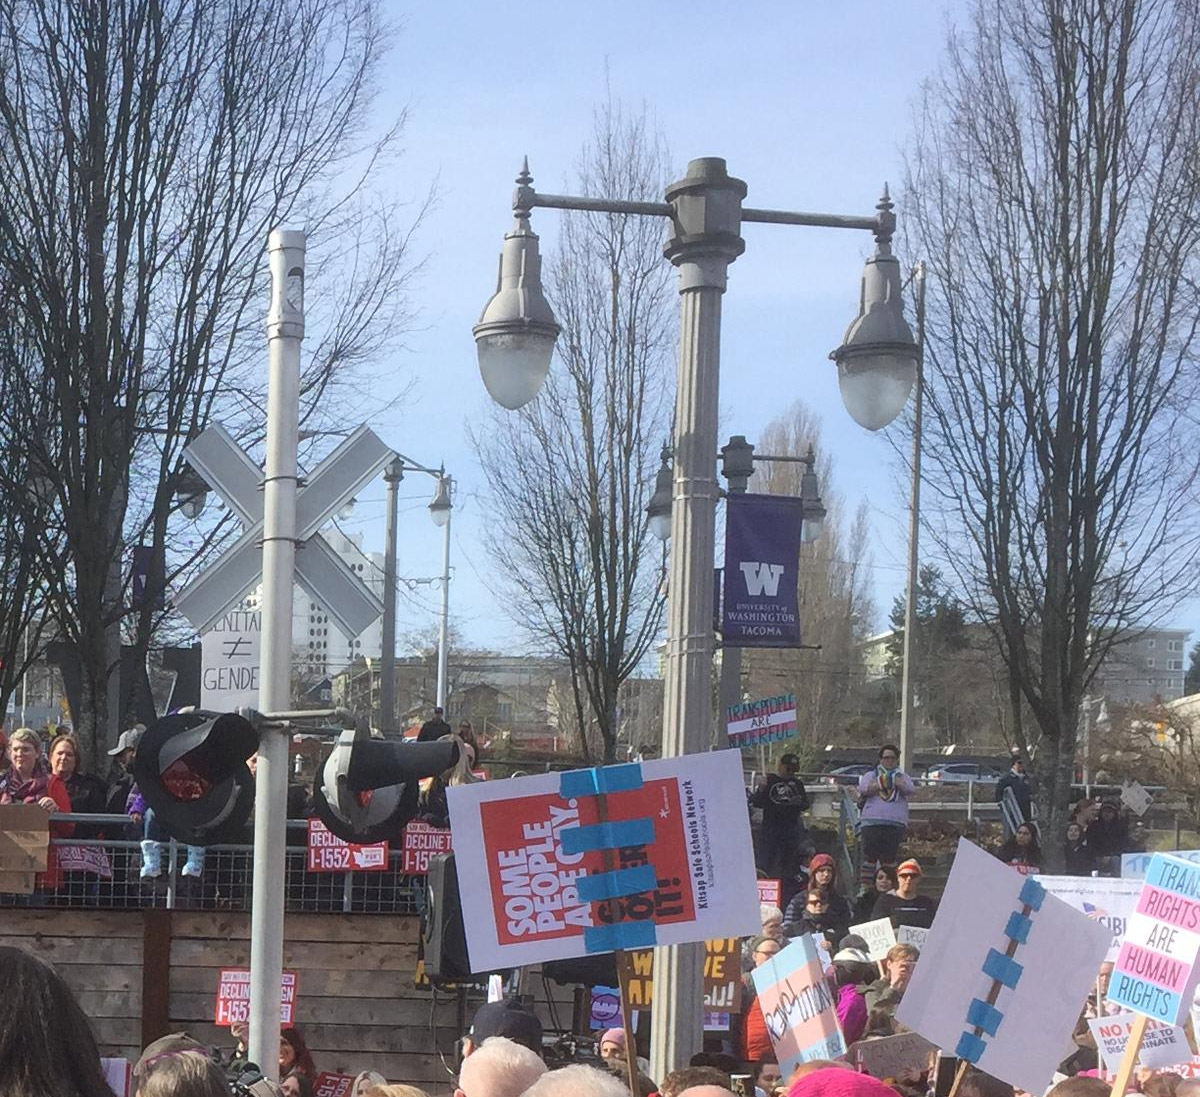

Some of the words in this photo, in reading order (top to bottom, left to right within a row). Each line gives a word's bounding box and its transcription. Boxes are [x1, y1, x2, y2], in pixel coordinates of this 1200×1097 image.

[739, 561, 784, 597] W
[728, 611, 795, 622] WASHINGTON
[736, 603, 780, 611] UNIVERSITY
[741, 625, 782, 636] TACOMA
[203, 666, 260, 691] GENDE
[682, 780, 696, 819] Network
[311, 832, 349, 847] DECLIN
[406, 834, 443, 849] DECLINE
[687, 820, 701, 855] Schools
[311, 848, 349, 868] I-1552
[405, 851, 445, 871] I-15
[692, 858, 704, 878] Safe
[523, 821, 565, 932] PEOPLE
[497, 848, 537, 936] SOME
[697, 880, 708, 909] Kitsap
[1145, 890, 1200, 930] RIGHTS
[1146, 923, 1179, 953] ARE
[1124, 946, 1182, 988] HUMAN
[220, 983, 250, 999] DECLIN
[1117, 975, 1172, 1016] RIGHTS
[218, 1000, 250, 1022] I-155
[1099, 1024, 1122, 1038] NO
[1104, 1037, 1117, 1046] NO
[1161, 1028, 1173, 1037] TO
